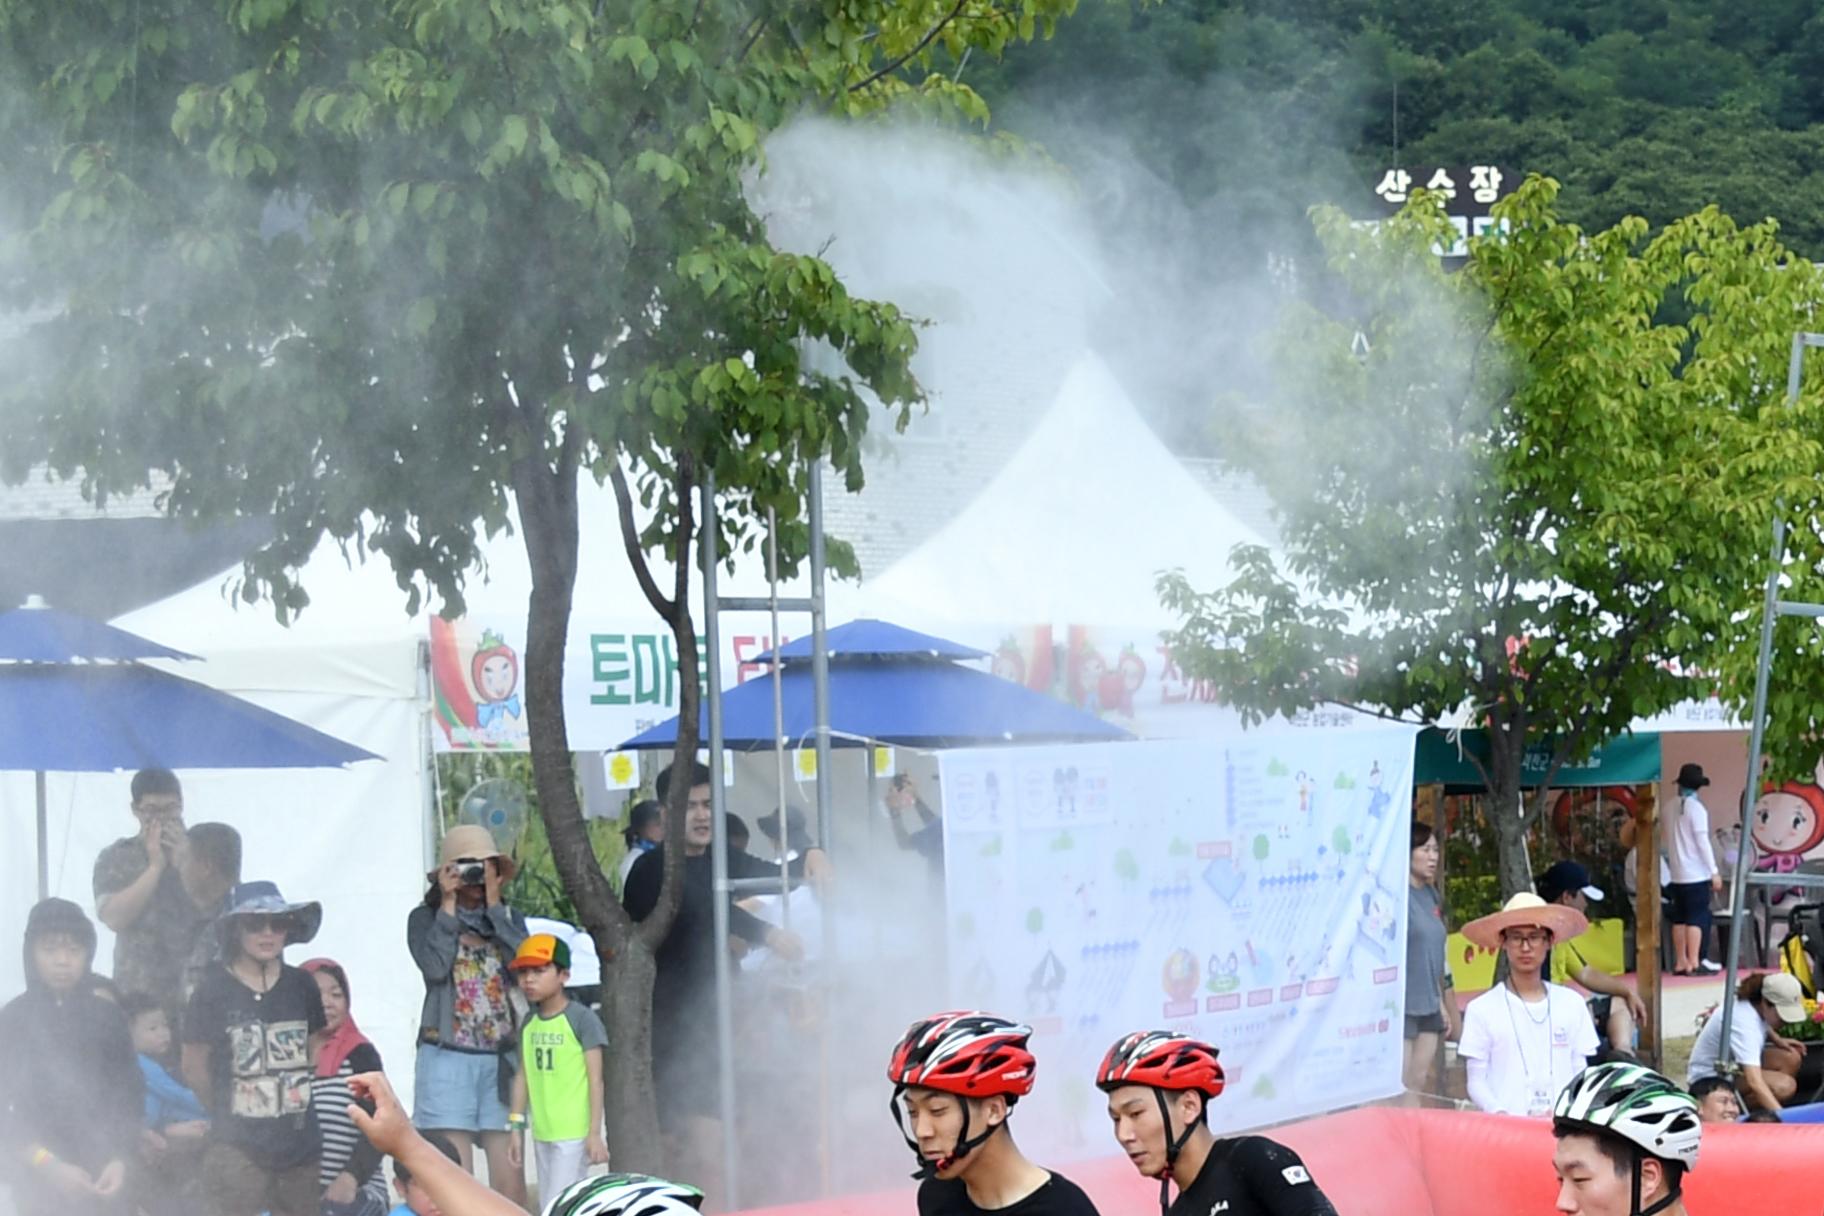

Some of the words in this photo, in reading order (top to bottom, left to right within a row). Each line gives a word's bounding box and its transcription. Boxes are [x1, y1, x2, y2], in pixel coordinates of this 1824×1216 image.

[1375, 165, 1503, 208] 산수장
[590, 634, 706, 707] 토마
[535, 1047, 554, 1071] 81
